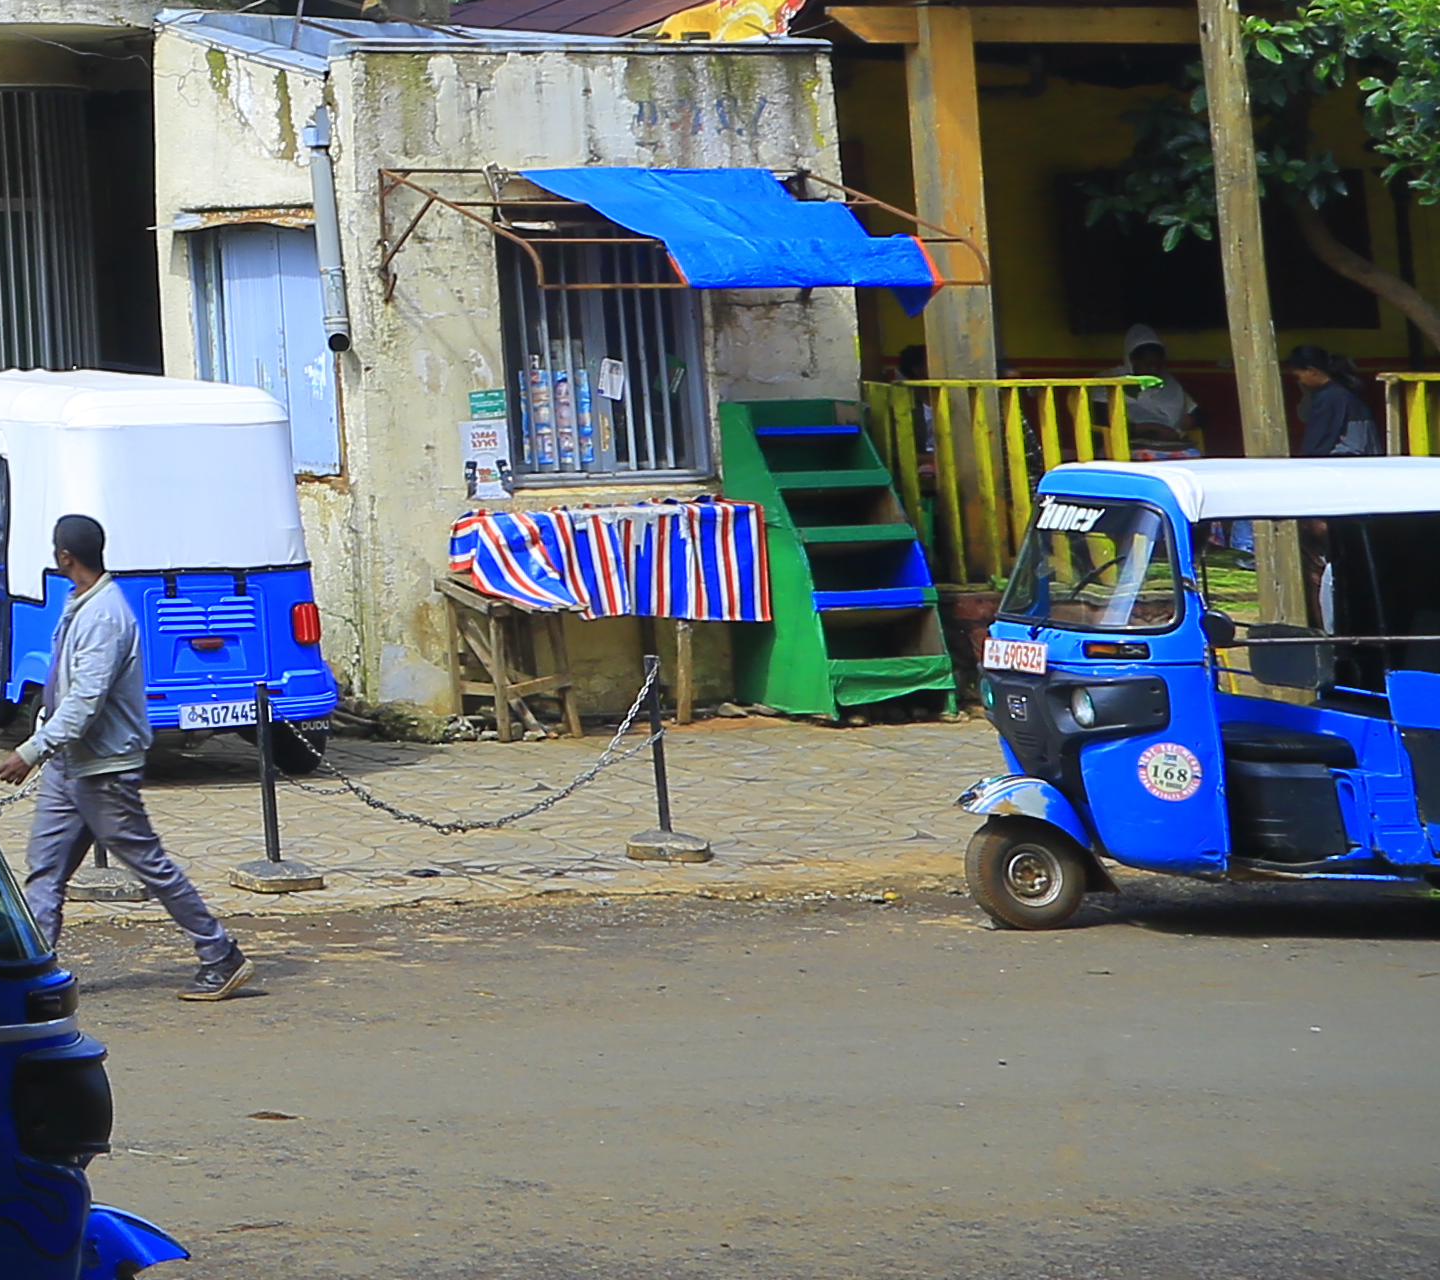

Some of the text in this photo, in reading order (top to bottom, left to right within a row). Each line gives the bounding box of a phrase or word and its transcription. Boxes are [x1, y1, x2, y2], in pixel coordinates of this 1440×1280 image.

[1003, 643, 1037, 669] 69032
[301, 720, 330, 731] DUDU
[1151, 764, 1189, 783] 168
